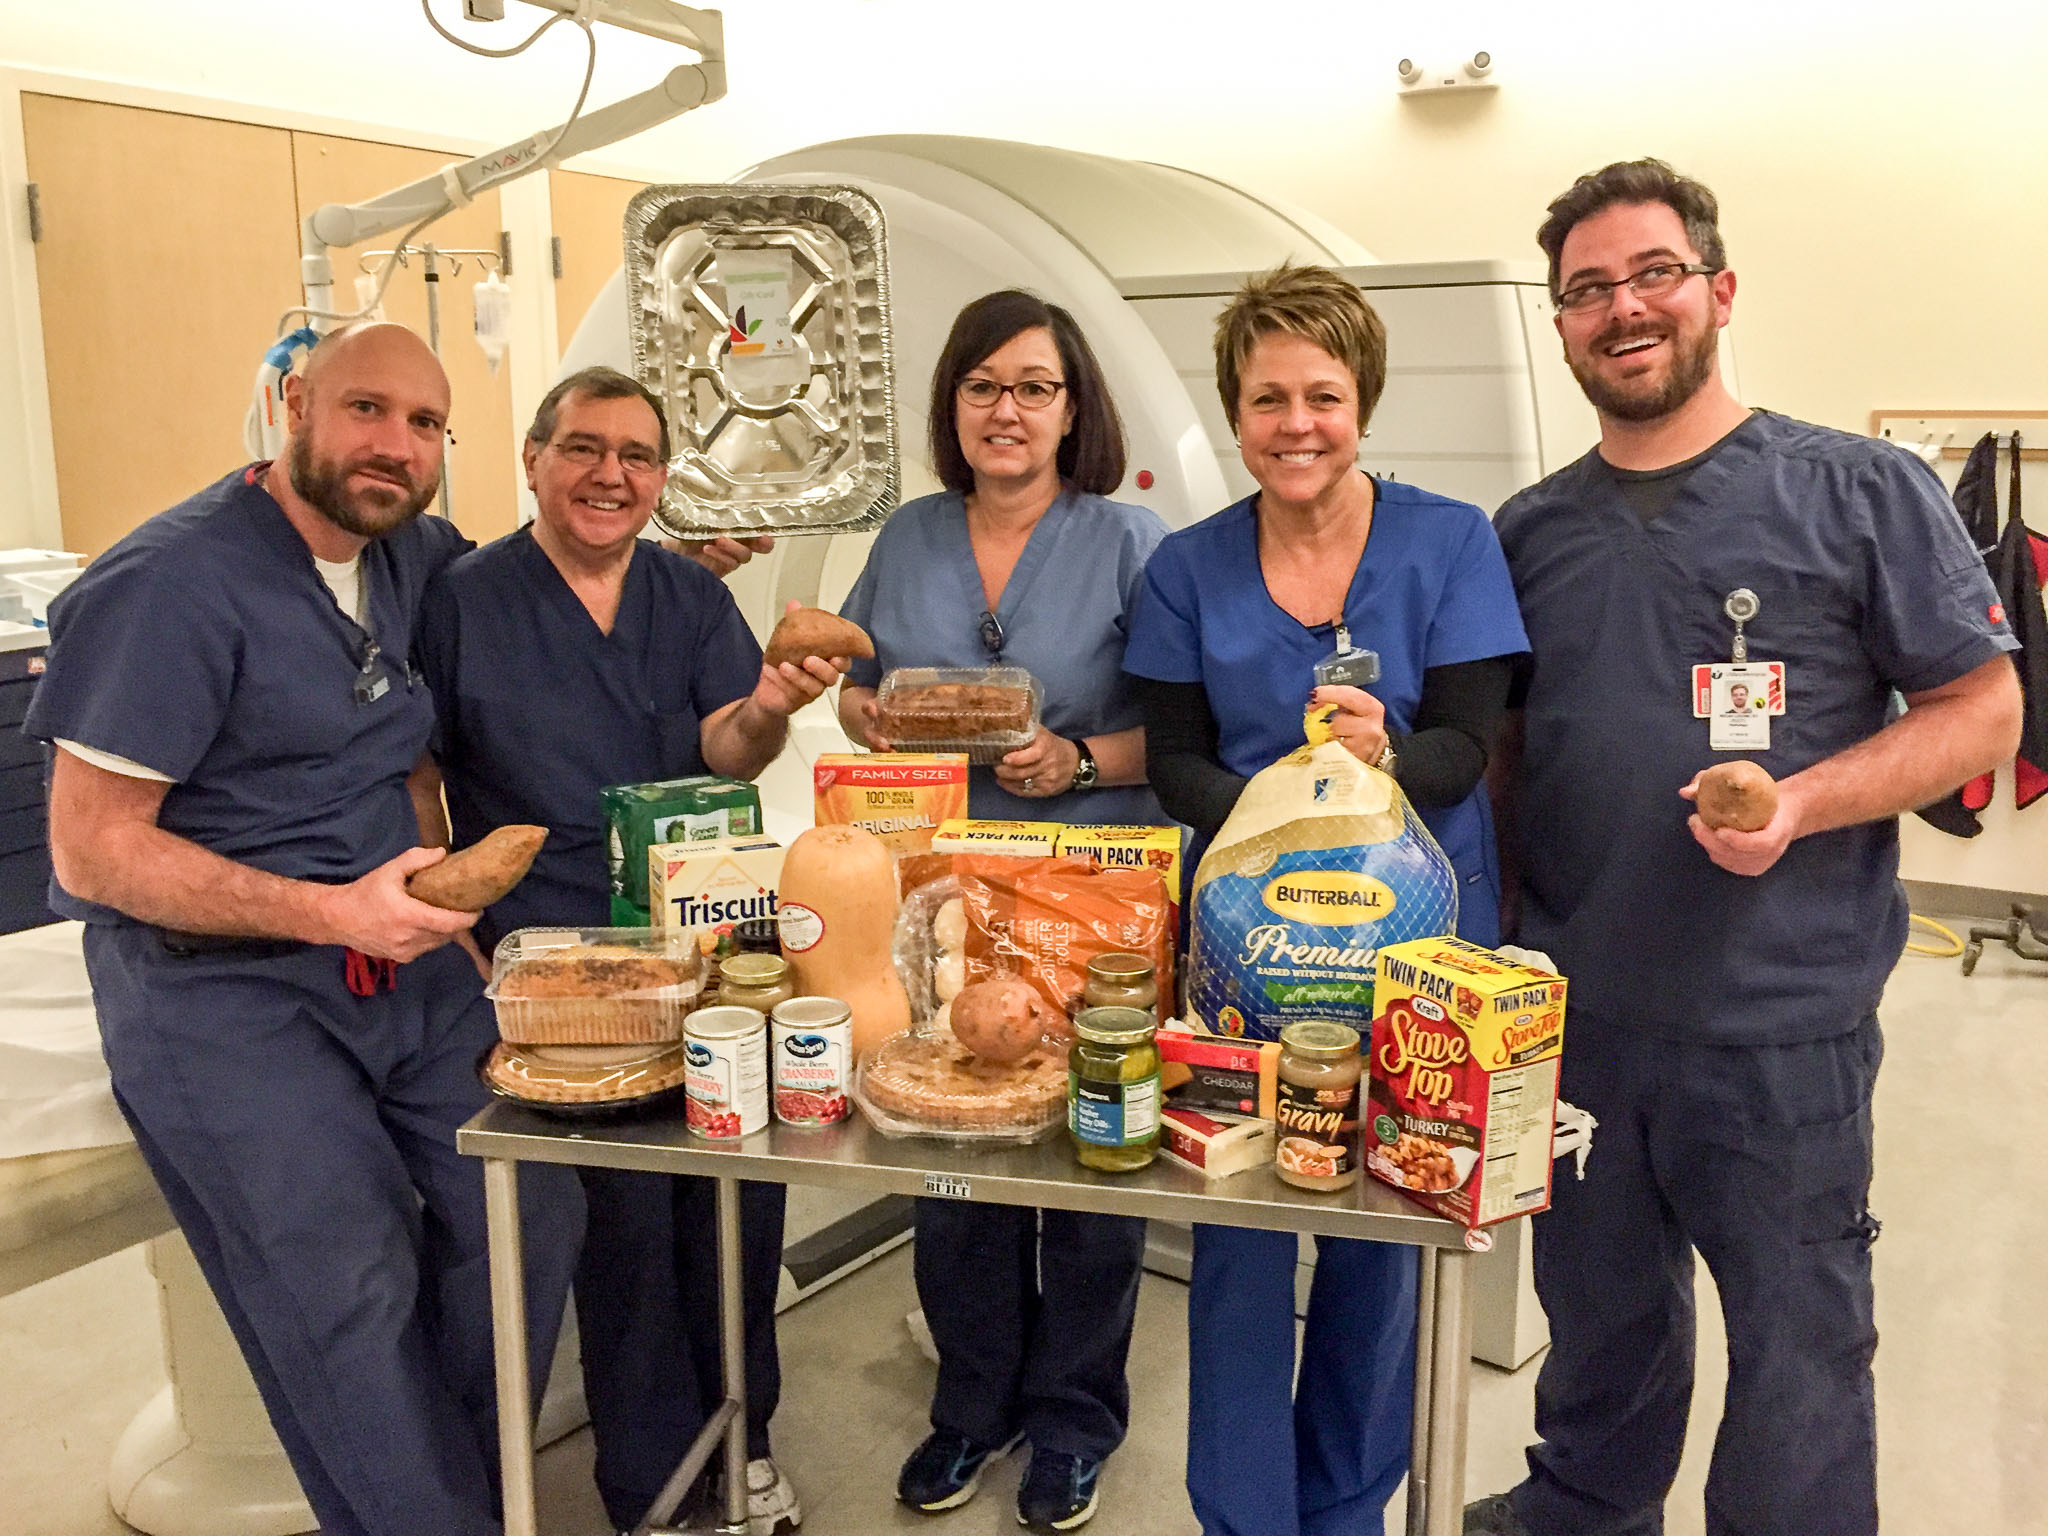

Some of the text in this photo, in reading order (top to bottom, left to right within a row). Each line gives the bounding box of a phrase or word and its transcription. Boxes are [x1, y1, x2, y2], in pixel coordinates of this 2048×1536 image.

[851, 769, 953, 780] FAMILY SIZE!
[966, 832, 1048, 842] TWIN PACK
[1107, 847, 1144, 866] PACK
[670, 886, 779, 927] Triscuit
[1276, 885, 1381, 907] BUTTERBALL
[1039, 921, 1056, 980] DINNER
[1056, 921, 1070, 966] ROLLS
[1238, 923, 1378, 969] Premiu
[1335, 971, 1376, 982] HORMON
[1383, 954, 1455, 1004] TWIN PACK
[1415, 999, 1440, 1019] Kraft
[1493, 988, 1547, 1013] TWIN PACK
[1379, 1009, 1468, 1074] Stove
[1202, 1076, 1255, 1090] CHEDDAR
[1404, 1060, 1454, 1106] Top
[1277, 1098, 1344, 1143] Gravy
[1404, 1114, 1450, 1137] TURKEY
[926, 1181, 969, 1197] BUILT
